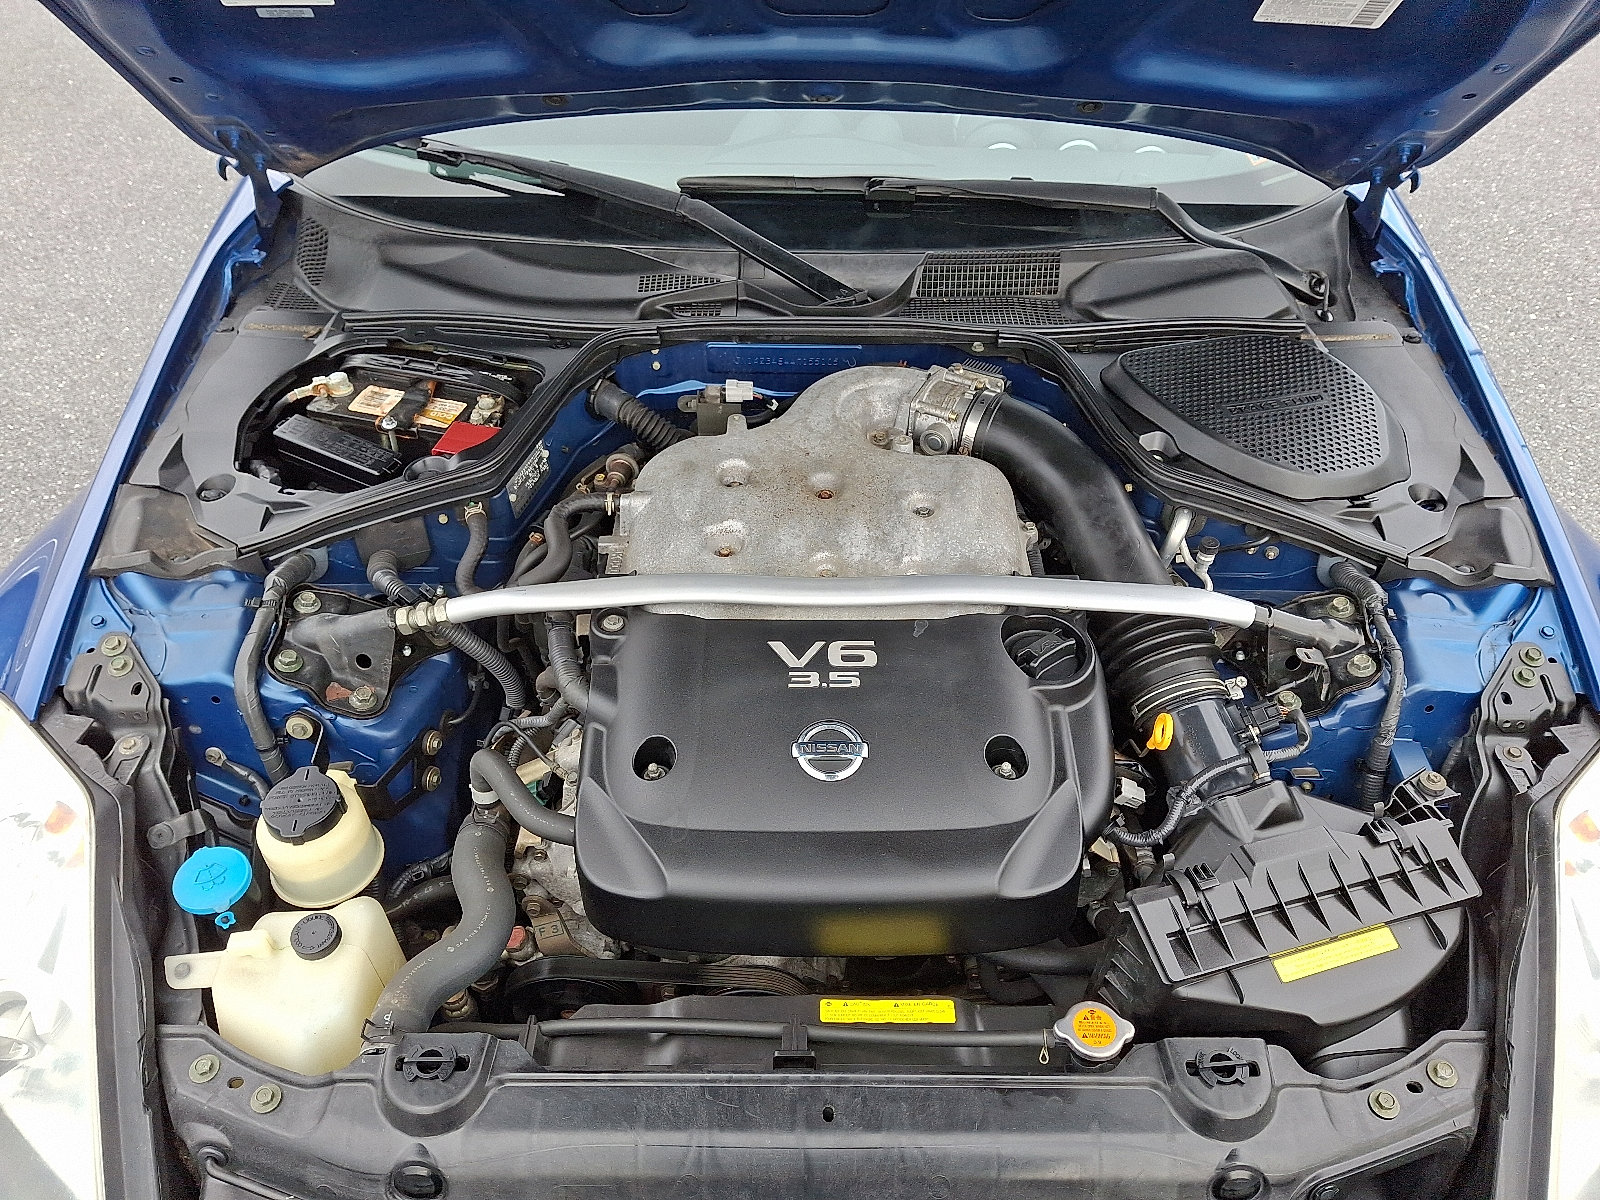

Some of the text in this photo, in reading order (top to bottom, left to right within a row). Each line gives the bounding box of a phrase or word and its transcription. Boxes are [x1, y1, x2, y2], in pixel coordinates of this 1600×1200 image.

[1226, 400, 1280, 416] BRAKE
[766, 640, 878, 668] V6
[787, 671, 861, 688] 3.5
[800, 743, 860, 753] NISSAN
